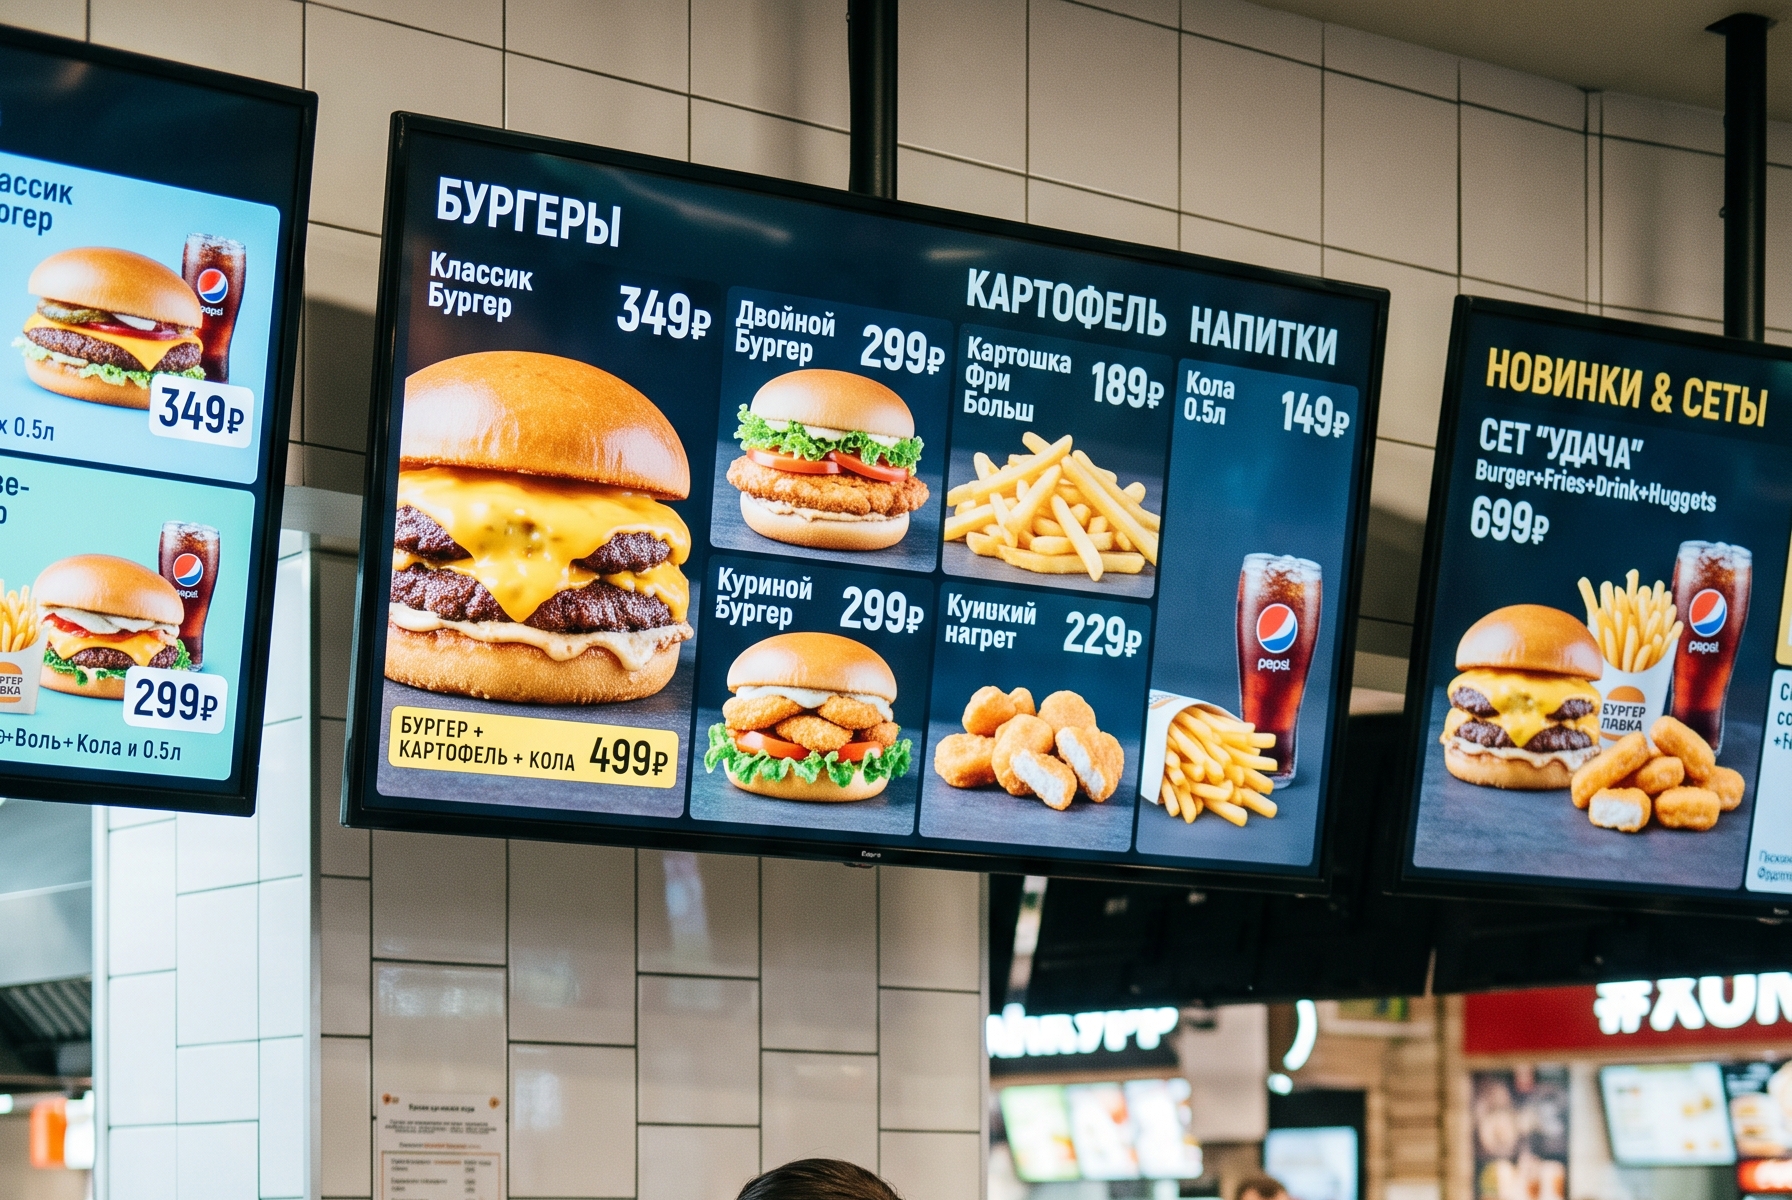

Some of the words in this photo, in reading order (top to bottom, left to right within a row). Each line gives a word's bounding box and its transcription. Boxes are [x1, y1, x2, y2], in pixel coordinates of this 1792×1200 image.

[437, 176, 621, 247] БУРГЕРЫ
[430, 251, 533, 291] Классик
[428, 281, 512, 322] Бургер
[616, 285, 712, 340] 349₽
[735, 300, 836, 337] Двойной
[966, 267, 1167, 337] КАРТОФЕЛЬ
[735, 328, 813, 366] Бургер
[860, 324, 946, 375] 299₽
[967, 335, 1072, 374] Картошка
[1190, 305, 1338, 366] НАПИТКИ
[965, 362, 1011, 394] Фри
[1091, 361, 1165, 409] 189₽
[1186, 370, 1235, 400] Кола
[1486, 347, 1643, 409] НОВИНКИ
[1650, 372, 1673, 414] &
[1682, 377, 1768, 428] СЕТЫ
[158, 386, 245, 435] 349₽
[963, 389, 1034, 422] Больш
[1183, 397, 1226, 425] 0.5л
[1281, 390, 1350, 439] 149₽
[14, 417, 54, 441] 0.5л
[1479, 417, 1531, 455] СЕТ
[1536, 425, 1644, 470] "УДАЧА"
[1470, 495, 1550, 545] 699₽
[717, 566, 813, 600] Куриной
[715, 594, 793, 630] Бургер
[839, 586, 924, 634] 299₽
[945, 624, 1017, 652] нагрет
[1063, 611, 1142, 658] 229₽
[133, 678, 218, 721] 299₽
[1602, 703, 1646, 718] БУРГЕР
[400, 715, 468, 739] БУРГЕР
[473, 726, 484, 738] +
[128, 743, 137, 757] и
[143, 739, 181, 761] 0.5л
[399, 739, 508, 766] КАРТОФЕЛЬ
[513, 753, 523, 764] +
[529, 750, 576, 772] КОЛА
[589, 736, 669, 776] 499₽
